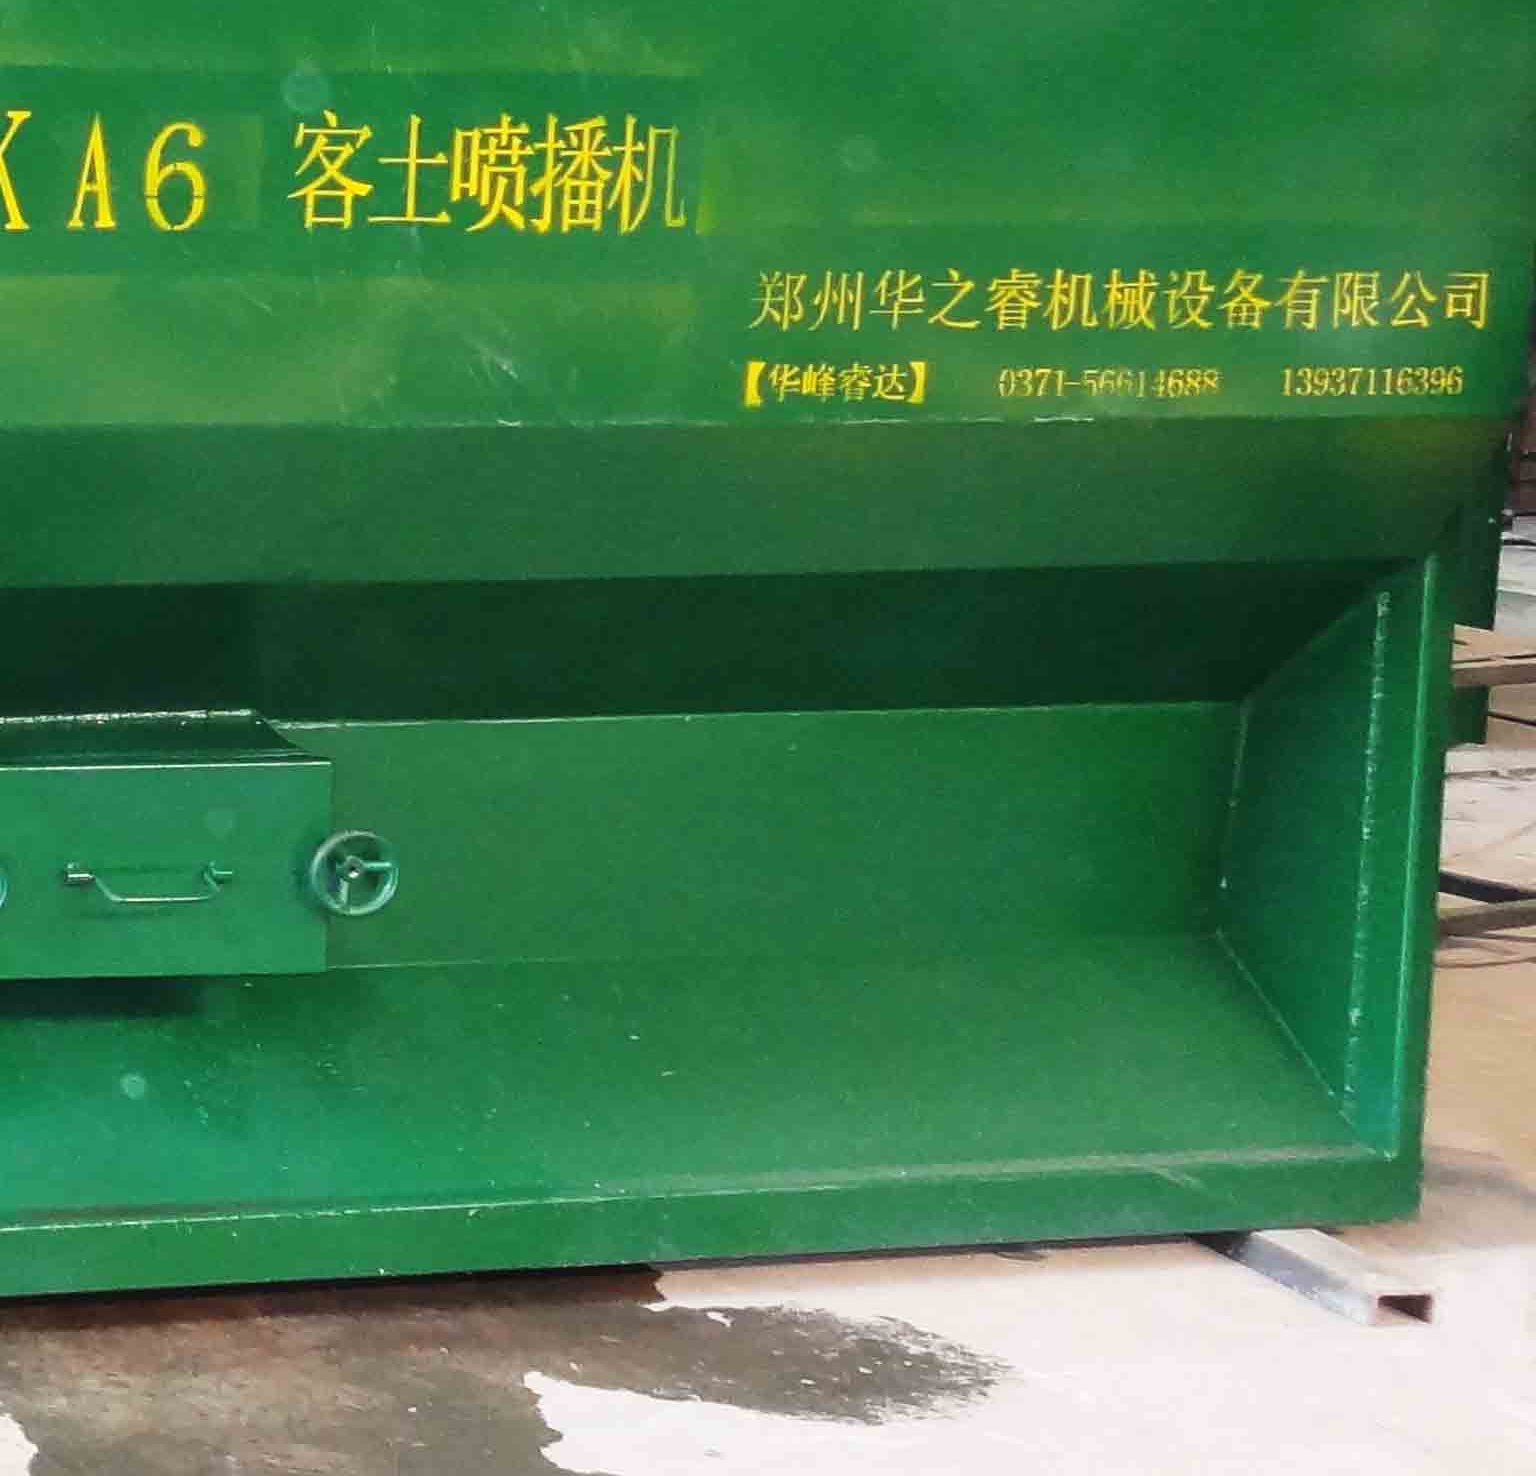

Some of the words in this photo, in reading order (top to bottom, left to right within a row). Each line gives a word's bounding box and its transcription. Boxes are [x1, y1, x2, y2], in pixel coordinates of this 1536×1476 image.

[286, 109, 688, 235] 客土喷播机
[748, 267, 1491, 332] 郑州华之睿机械设备有限公司
[1281, 366, 1464, 397] 13937116396
